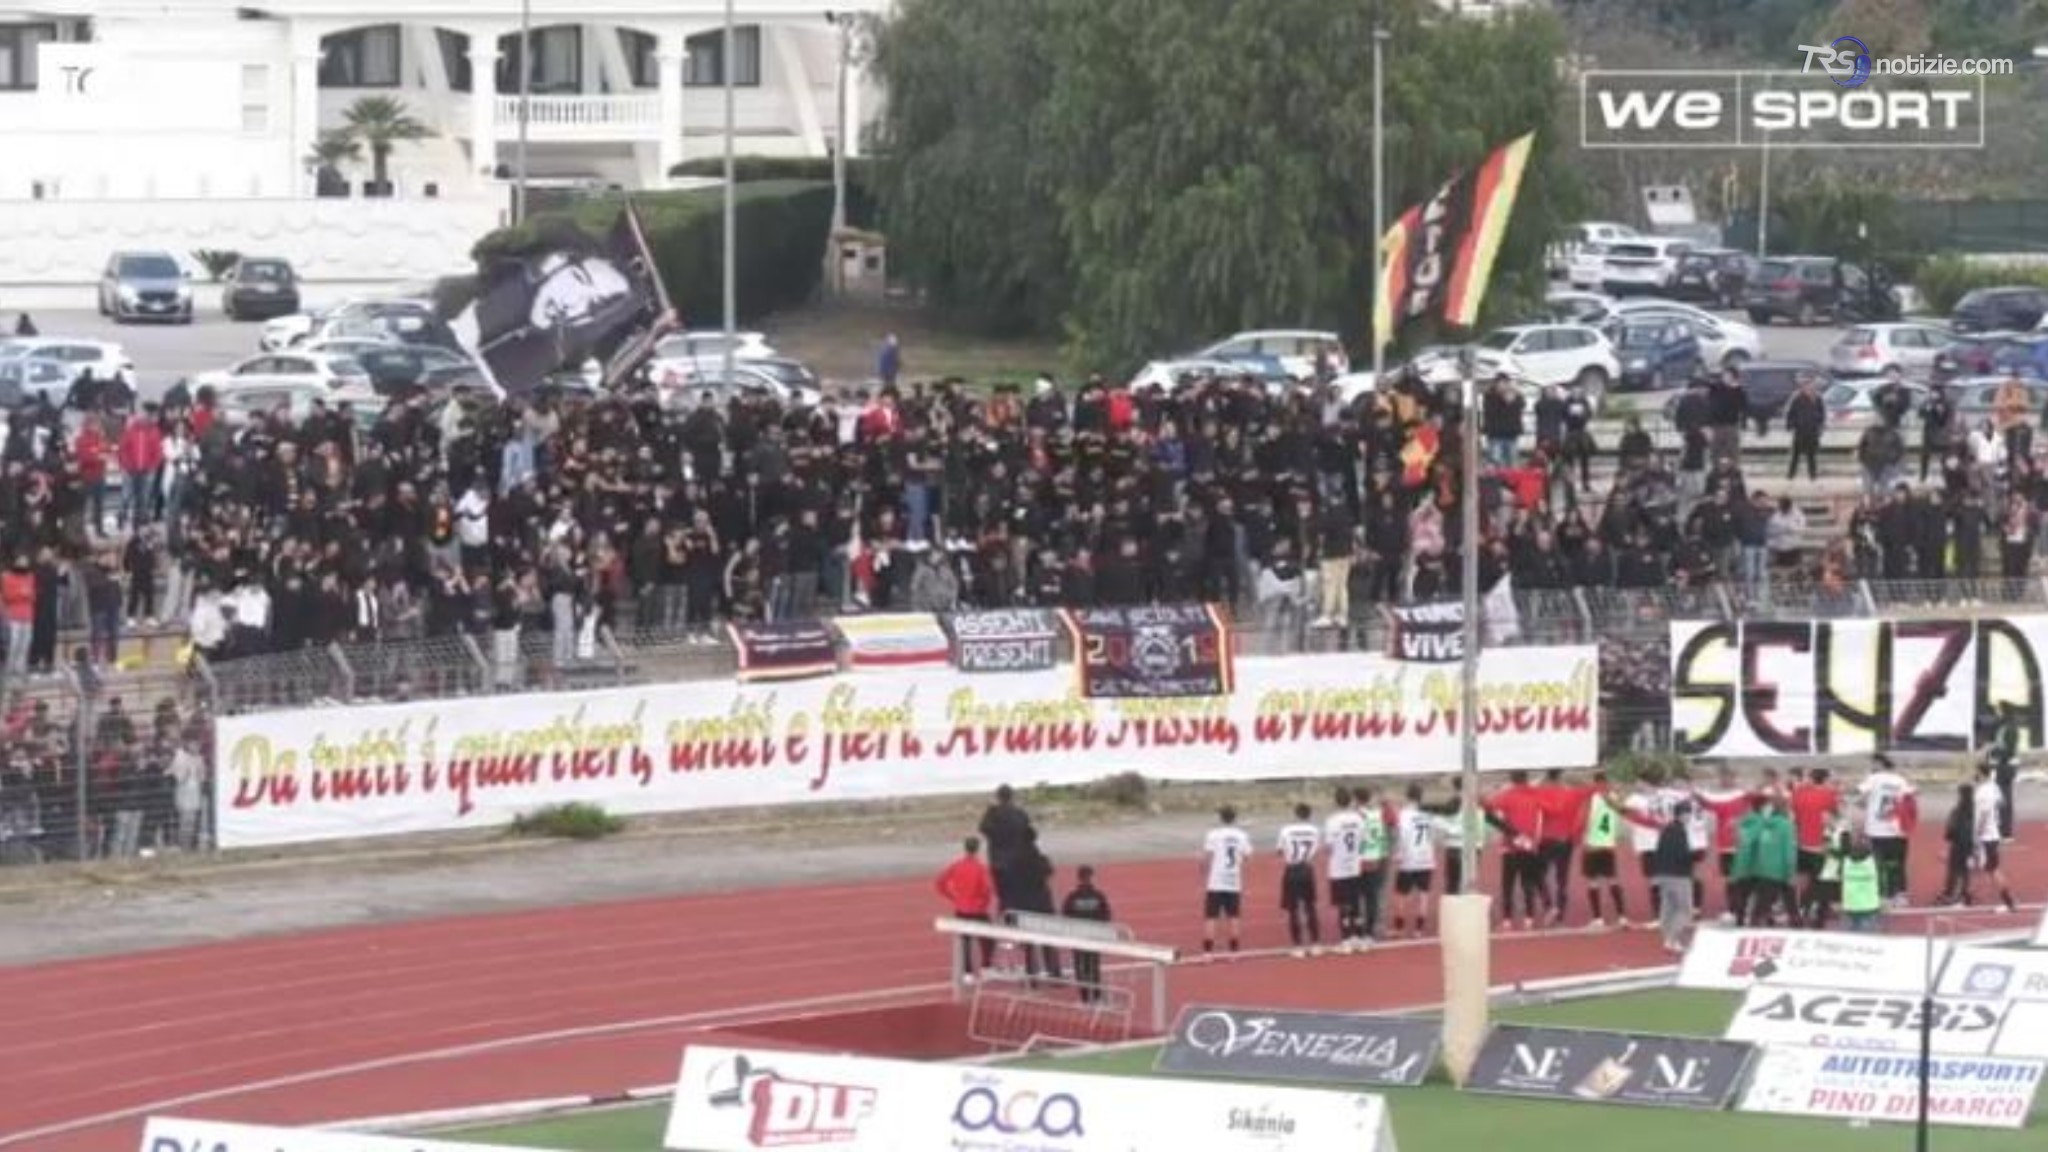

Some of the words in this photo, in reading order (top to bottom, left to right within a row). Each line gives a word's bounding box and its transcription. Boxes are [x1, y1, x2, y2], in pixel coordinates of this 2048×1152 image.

[1673, 618, 2046, 755] SENZA
[230, 733, 298, 809] Da
[309, 717, 412, 801] tutti
[422, 714, 440, 793] i
[667, 688, 776, 773] uniti
[786, 711, 809, 765] e
[1253, 662, 1407, 745] avanti
[1747, 992, 1999, 1032] ACERBIS
[1186, 1011, 1400, 1067] VENEZIA
[1820, 1054, 2039, 1084] AUTOTRASPORTI
[1806, 1088, 1878, 1112] PINO
[1883, 1093, 1917, 1115] DI
[1925, 1095, 2025, 1119] MARCO
